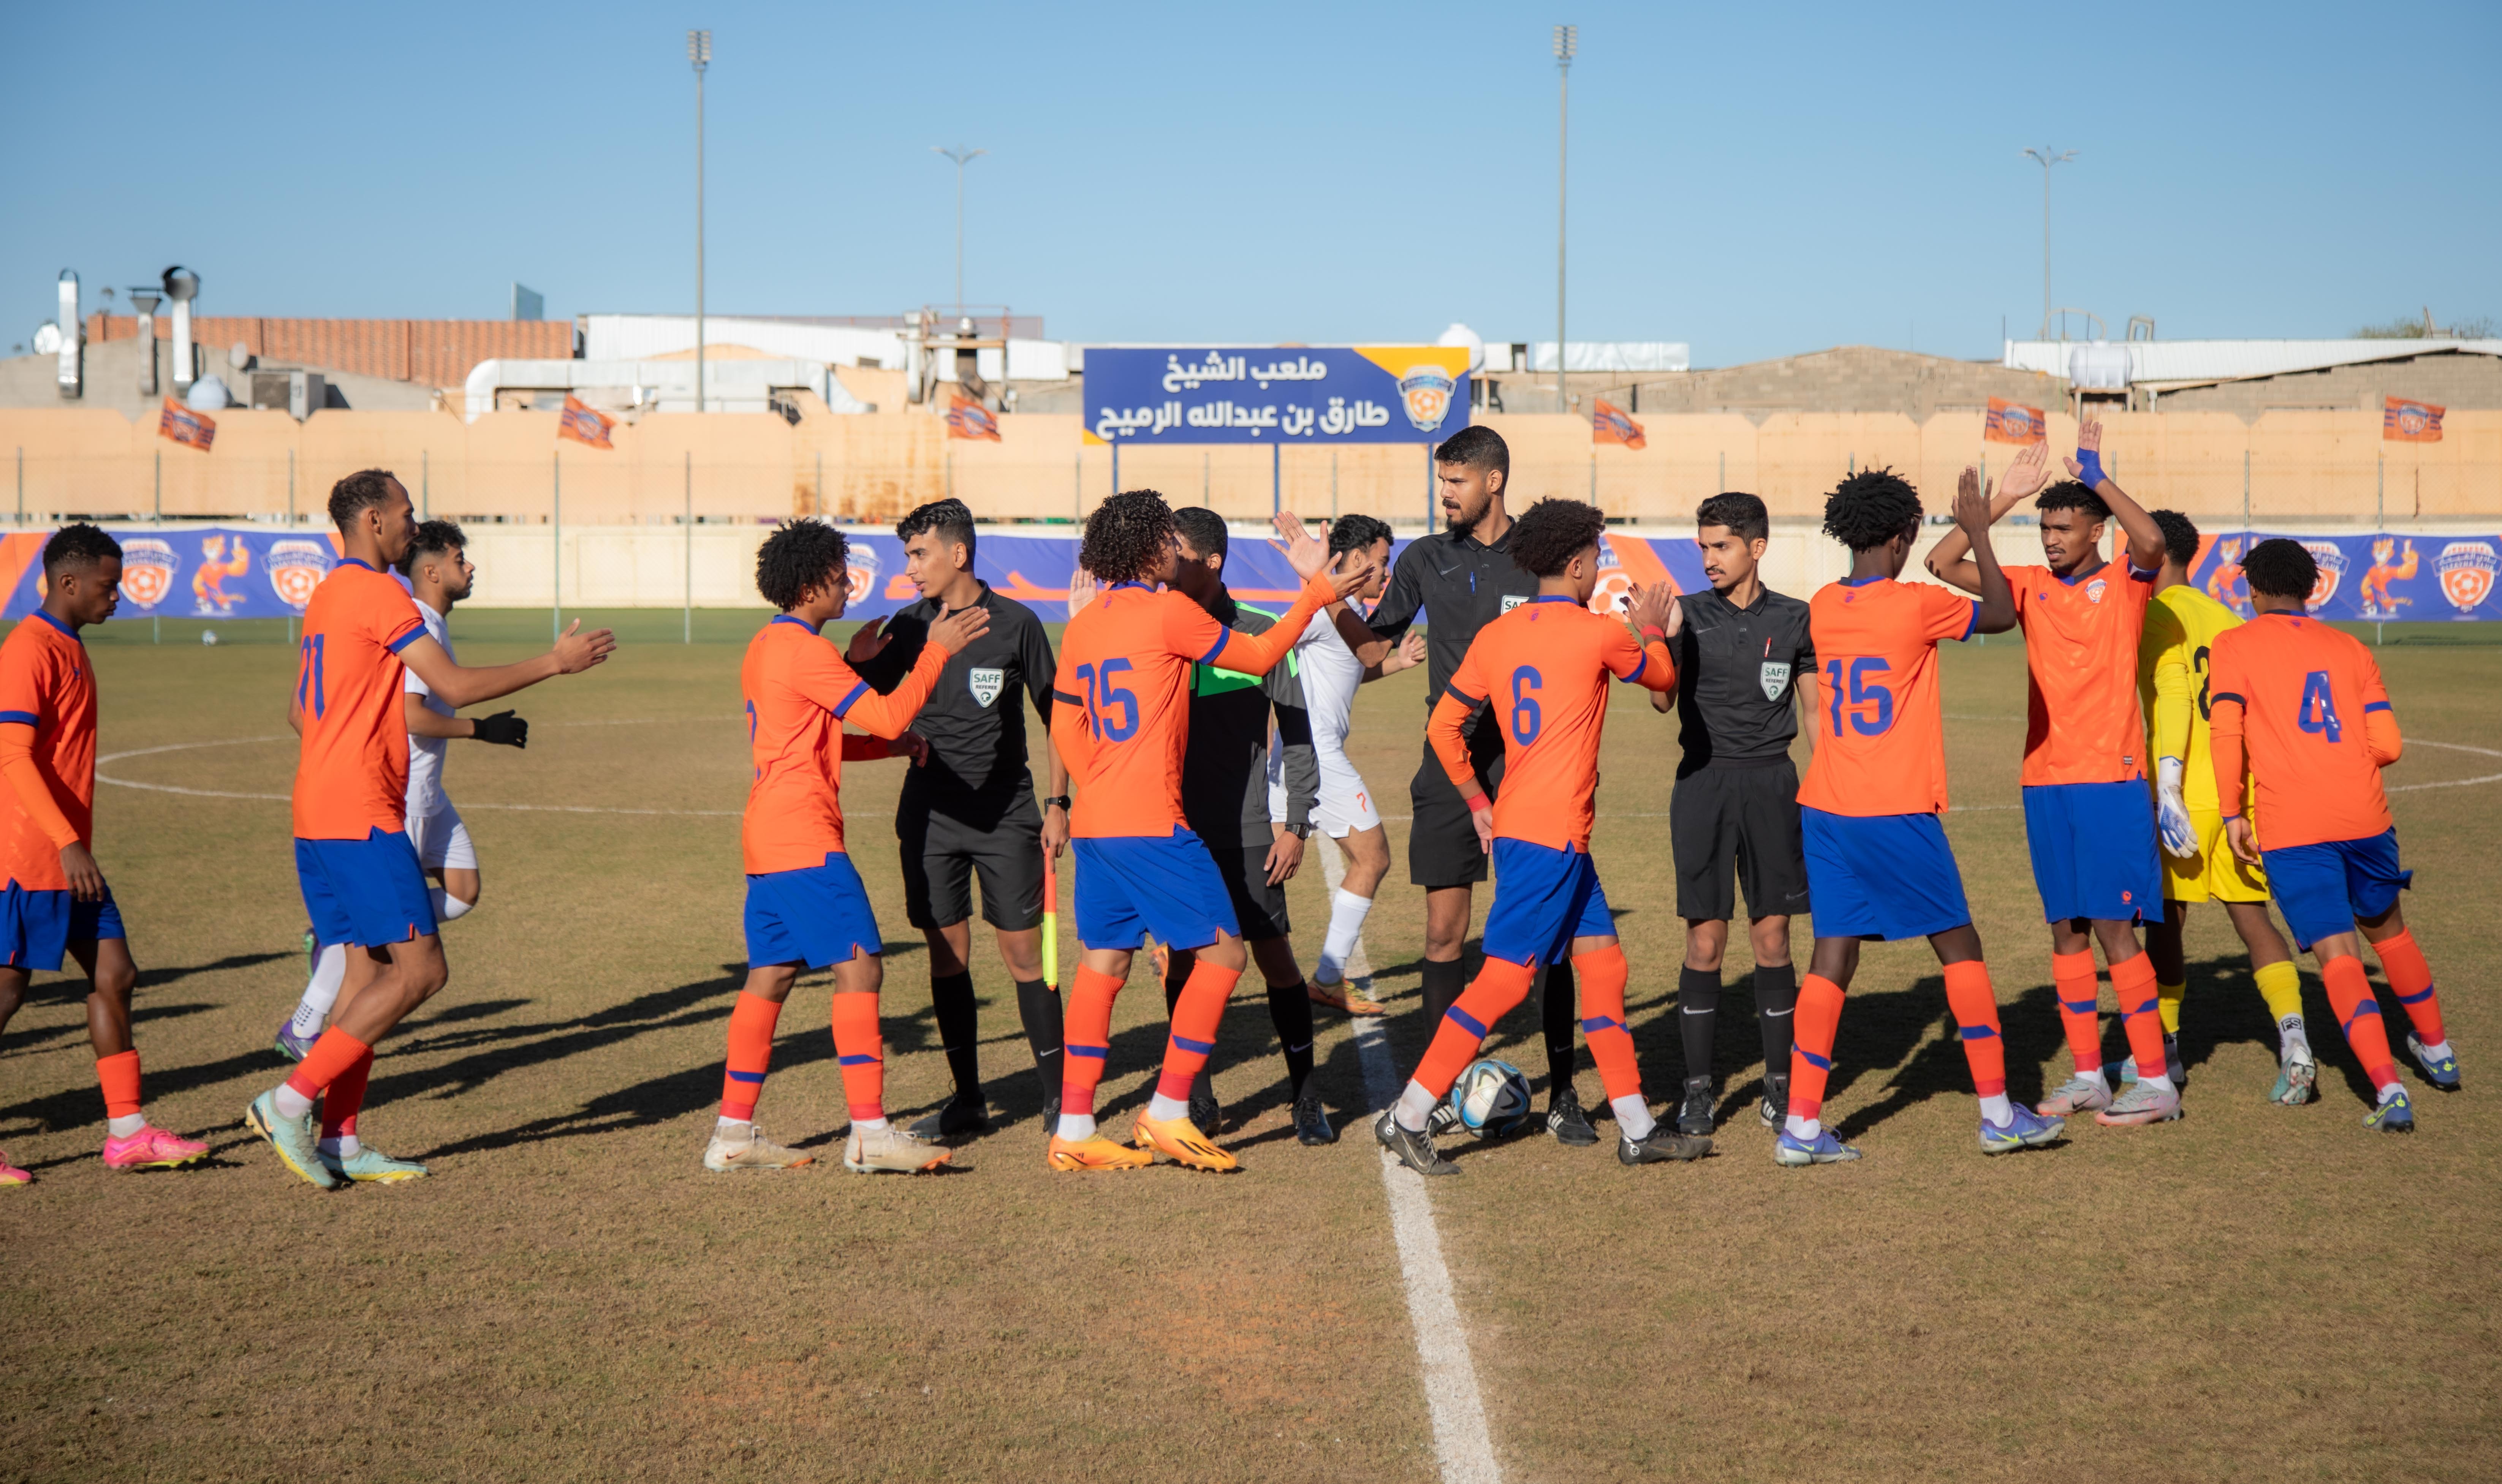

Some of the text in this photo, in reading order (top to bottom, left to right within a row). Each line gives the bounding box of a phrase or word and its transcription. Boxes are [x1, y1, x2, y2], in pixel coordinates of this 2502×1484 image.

[1163, 351, 1327, 392] ملعب الشيخ
[1097, 398, 1389, 440] طارق بن عبدالله الرميح
[973, 673, 1000, 683] SAFF
[1765, 667, 1788, 677] SAFF
[1512, 665, 1542, 746] 6
[1826, 657, 1893, 736] 15
[2298, 670, 2342, 743] 4
